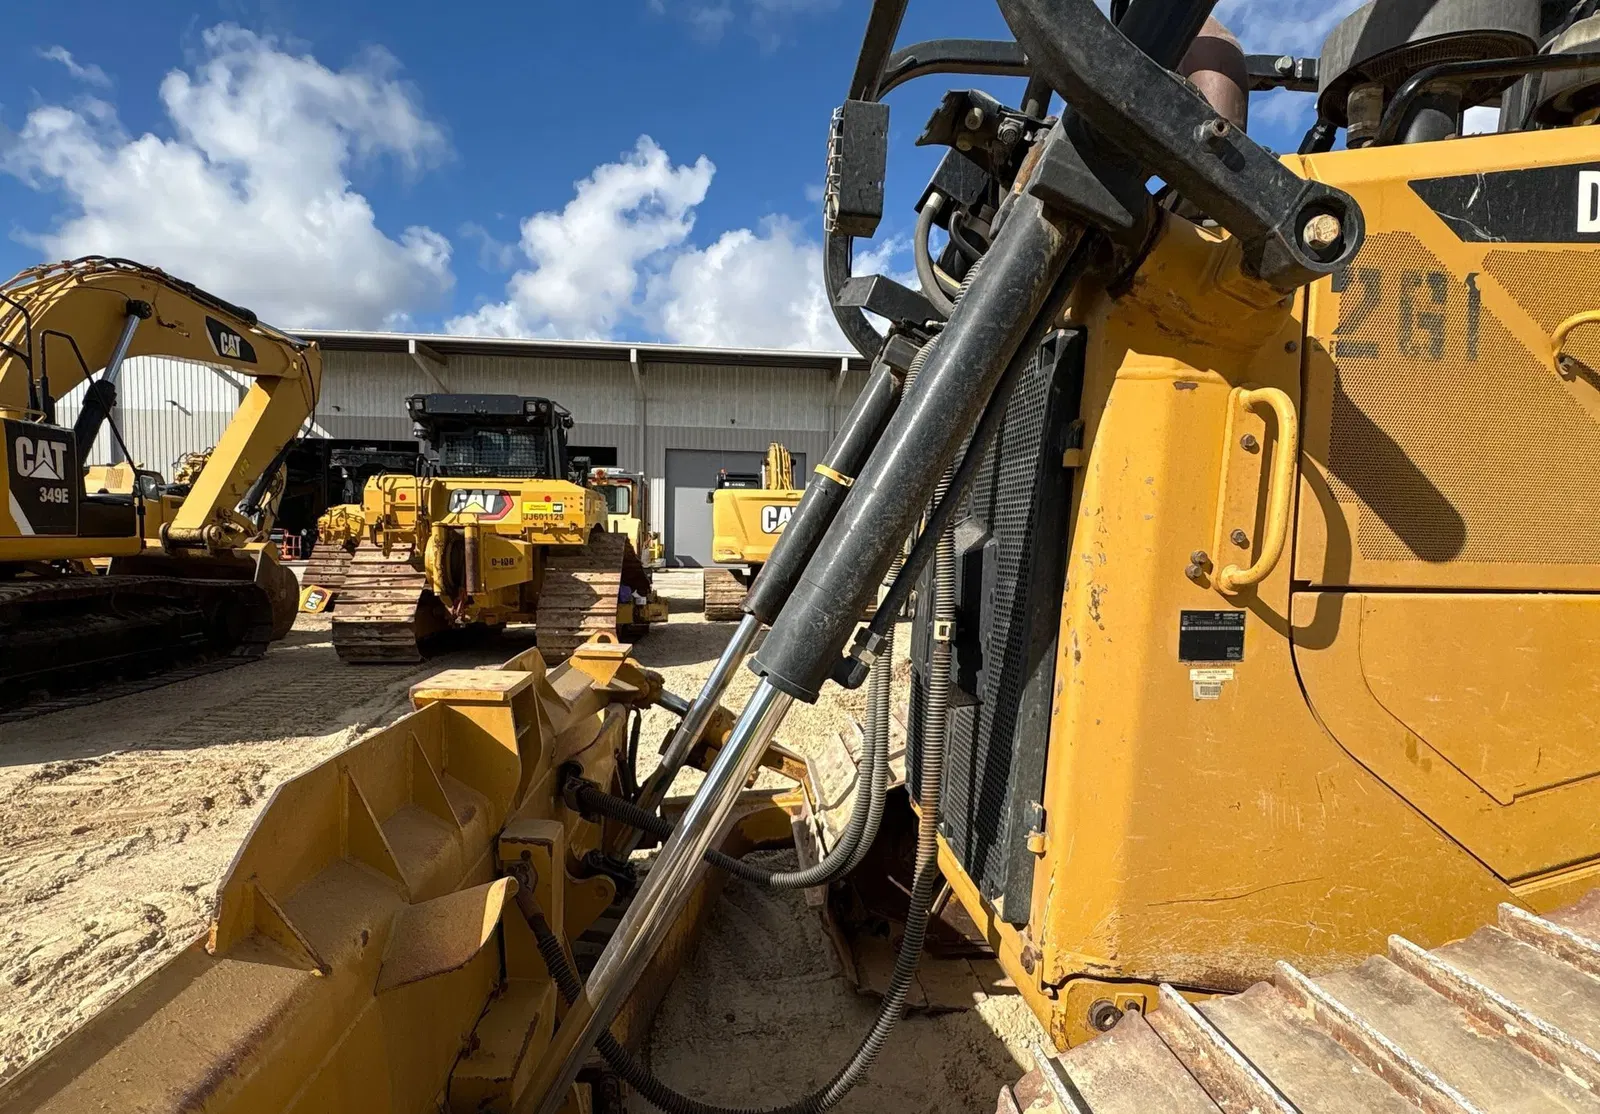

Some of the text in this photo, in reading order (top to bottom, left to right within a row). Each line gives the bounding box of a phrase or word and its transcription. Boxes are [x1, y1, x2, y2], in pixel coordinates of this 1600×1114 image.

[220, 331, 241, 357] CAT
[15, 436, 67, 481] CAT
[39, 486, 69, 504] 349E
[449, 489, 500, 514] CAT
[523, 513, 565, 521] JJ601129
[762, 506, 797, 534] CA
